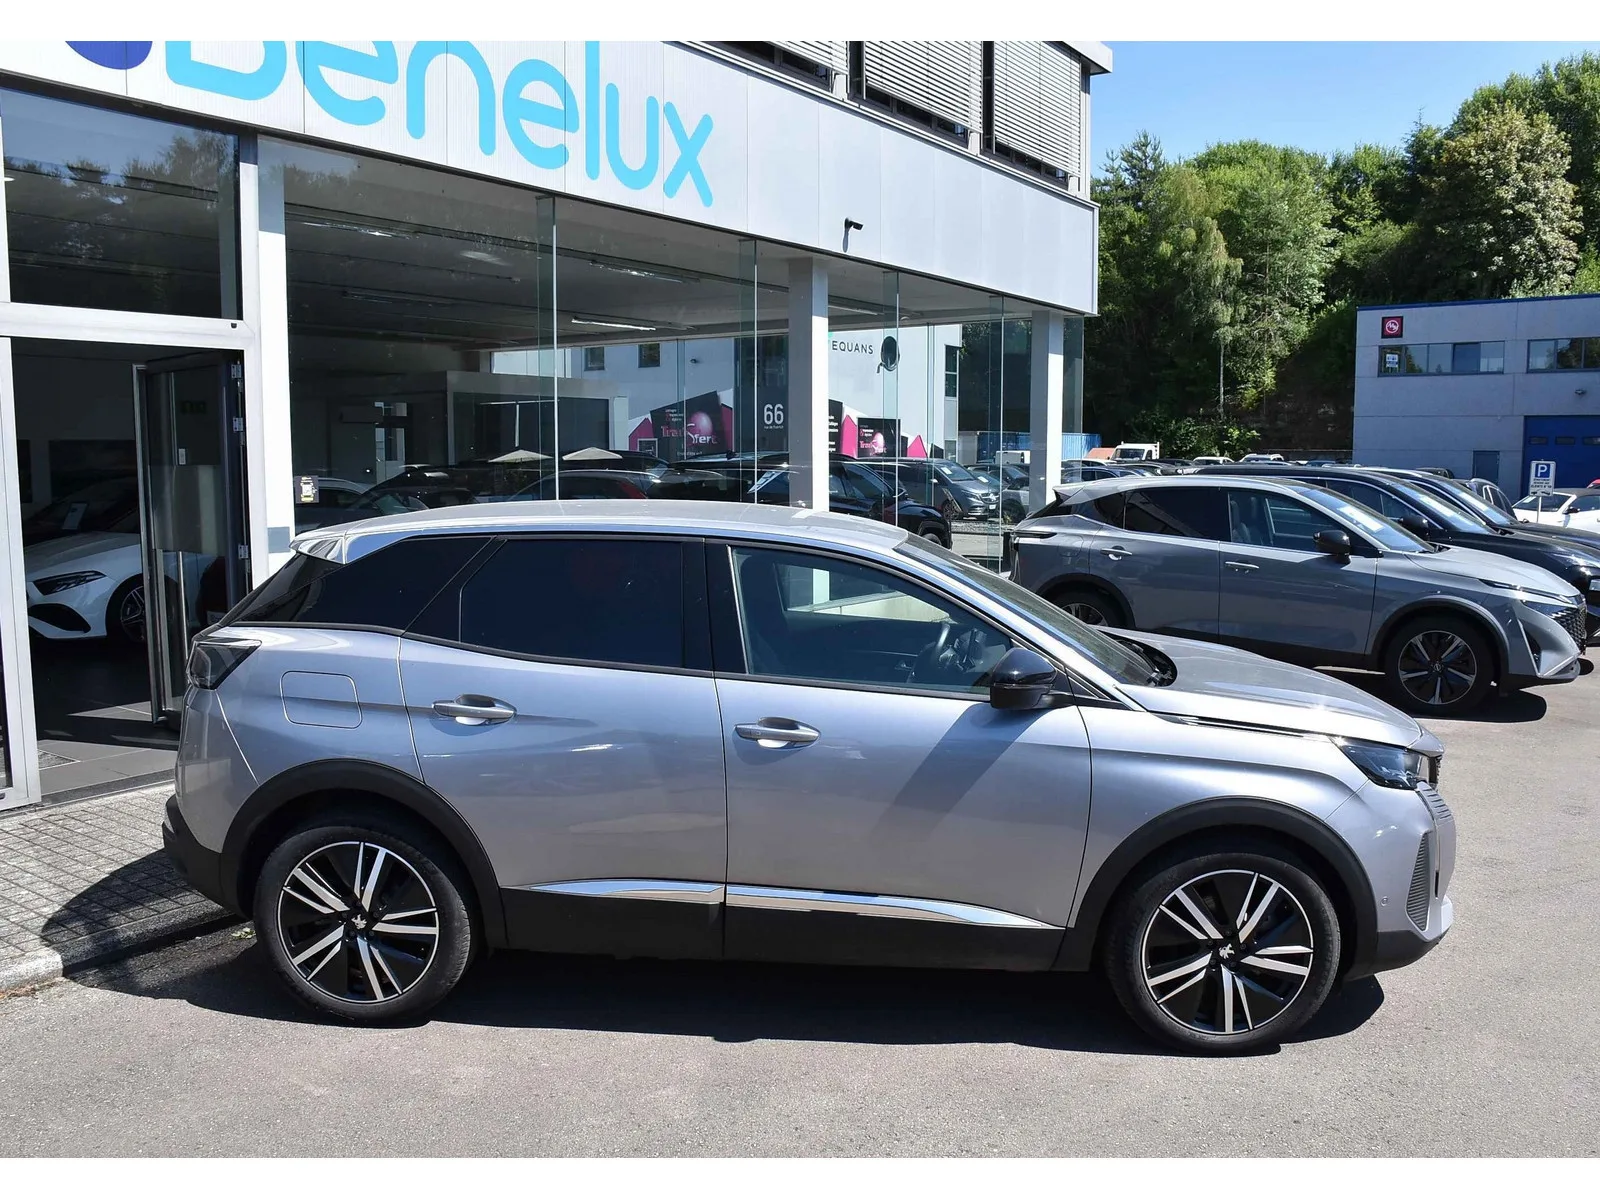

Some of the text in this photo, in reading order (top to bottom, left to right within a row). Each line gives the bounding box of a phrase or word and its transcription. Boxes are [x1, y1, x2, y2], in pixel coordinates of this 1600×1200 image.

[831, 340, 874, 355] EQUANS
[763, 403, 784, 425] 66
[1537, 464, 1548, 477] P
